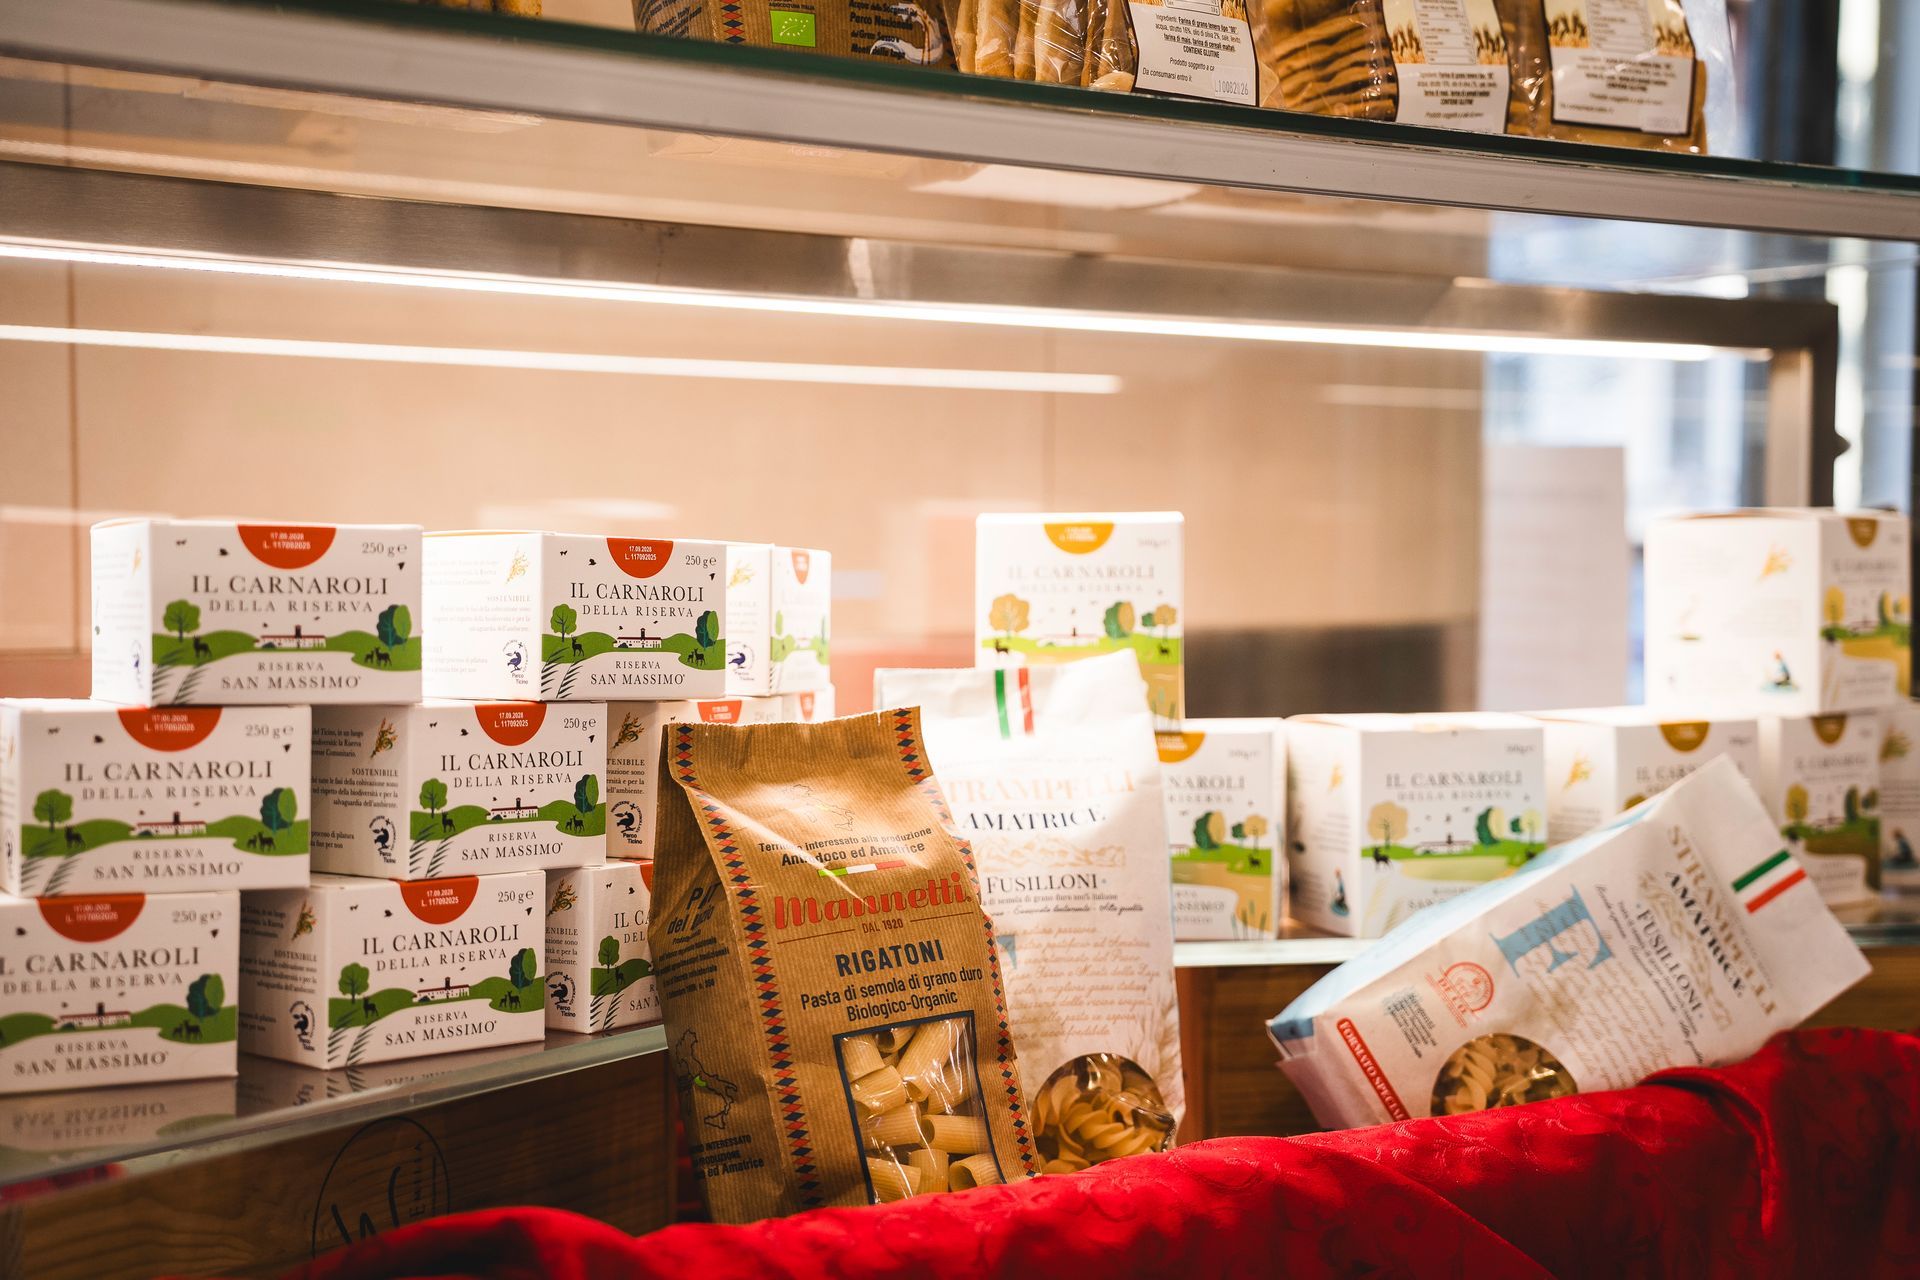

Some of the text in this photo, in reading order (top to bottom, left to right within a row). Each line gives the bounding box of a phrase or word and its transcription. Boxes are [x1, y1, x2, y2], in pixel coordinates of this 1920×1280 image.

[1142, 67, 1149, 75] Da
[1150, 69, 1176, 80] consumarsi
[361, 542, 384, 555] 250
[685, 555, 701, 566] 250
[1033, 564, 1155, 579] CARNAROLI
[192, 575, 389, 596] IL CARNAROLI
[571, 582, 704, 602] IL CARNAROLI
[208, 599, 374, 613] DELLA RISERVA
[582, 604, 694, 618] DELLA RISERVA
[257, 661, 325, 672] RISERVA
[615, 660, 661, 670] RISERVA
[221, 676, 261, 689] SAN
[590, 673, 686, 686] SAN MASSIMO
[246, 724, 270, 737] 250
[494, 720, 500, 728] L.
[564, 718, 580, 729] 250
[441, 750, 583, 772] IL CARNAROLI
[64, 760, 273, 782] IL CARNAROLI
[352, 768, 398, 776] SOSTENIBILE
[1385, 770, 1523, 788] IL CARNAROLI
[454, 773, 572, 788] DELLA RISERVA
[628, 779, 638, 788] per
[1169, 775, 1246, 790] NAROLI
[82, 784, 258, 800] DELLA RISERVA
[488, 832, 537, 842] RISERVA
[805, 837, 859, 851] interessato
[881, 827, 932, 844] produzione
[133, 848, 204, 860] RISERVA
[462, 842, 564, 862] SAN MASSIMO
[851, 841, 925, 859] ed Amatrice
[93, 864, 136, 880] SAN
[987, 874, 1098, 894] FUSILLONI
[497, 890, 516, 903] 250
[774, 872, 972, 929] Mannetti
[172, 910, 196, 923] 250
[614, 912, 629, 928] IL
[862, 918, 904, 934] DAL 1920
[362, 923, 519, 955] IL CARNAROLI
[624, 932, 645, 944] DEL
[25, 947, 200, 975] CARNAROLI
[376, 948, 508, 972] DELLA RISERVA
[835, 939, 945, 977] RIGATONI
[1635, 909, 1703, 1013] FUSILLONI
[3, 973, 183, 994] DELLA RISERVA
[801, 967, 982, 1010] Pasta di semola di grano duro
[630, 999, 650, 1011] SAN
[847, 989, 958, 1022] Biologico-Organic
[415, 1011, 468, 1025] RISERVA
[385, 1020, 497, 1047] SAN MASSIMO
[55, 1039, 129, 1053] RISERVA
[1338, 1020, 1377, 1076] FORMATO
[14, 1059, 57, 1076] SAN
[722, 1158, 765, 1175] Amatrice
